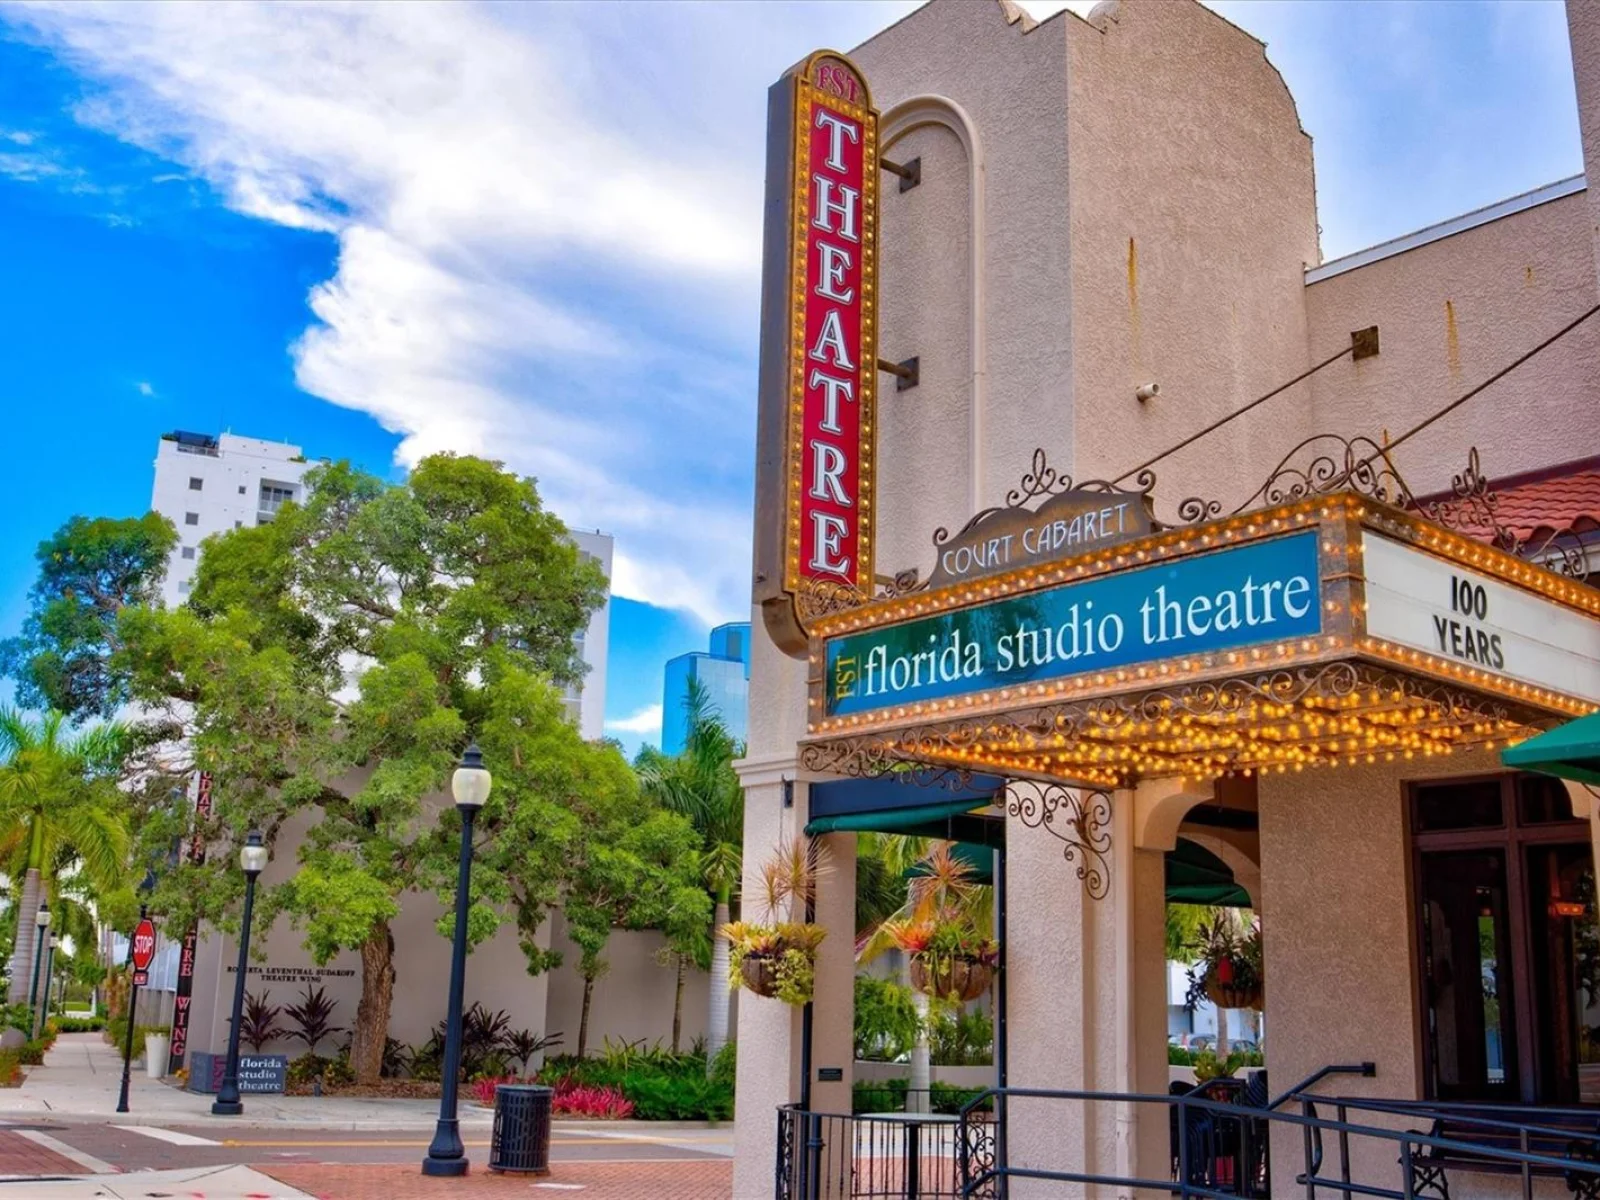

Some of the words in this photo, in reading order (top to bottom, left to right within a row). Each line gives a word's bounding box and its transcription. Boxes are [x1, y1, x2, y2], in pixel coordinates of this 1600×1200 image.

[816, 64, 858, 104] FST
[809, 107, 860, 575] THEATRE
[942, 534, 1015, 576] COURT
[1022, 503, 1129, 554] CABARET
[1451, 575, 1487, 621] 100
[864, 629, 983, 697] florida
[996, 600, 1125, 673] studio
[1139, 574, 1312, 645] theatre
[1432, 614, 1504, 670] YEARS
[836, 655, 856, 701] FST
[134, 935, 153, 955] STOP
[261, 974, 297, 982] THEATRE
[171, 996, 191, 1056] WING
[239, 1069, 277, 1079] studio
[239, 1080, 281, 1090] theatre
[240, 1057, 282, 1068] florida
